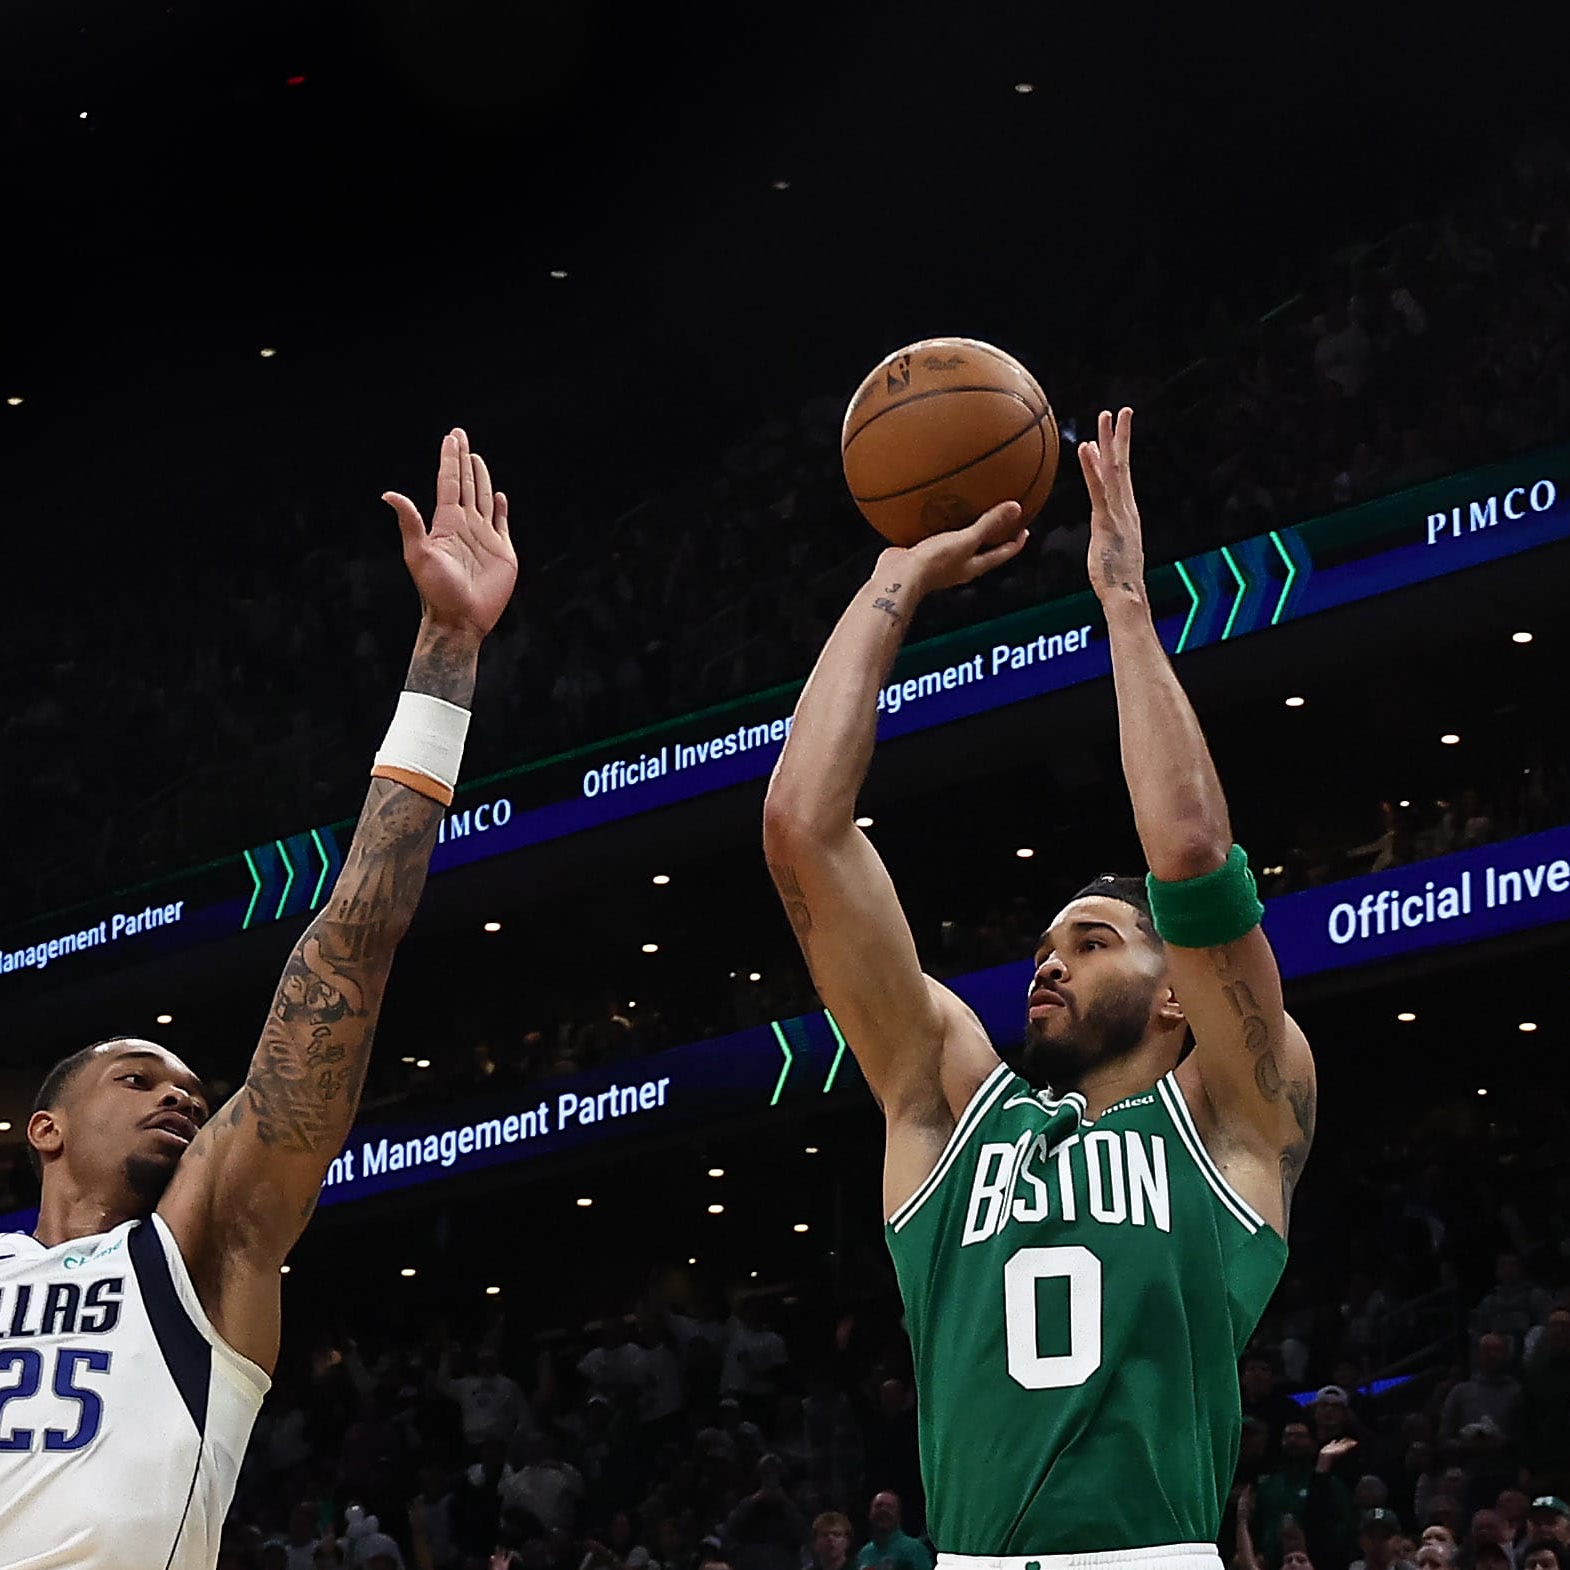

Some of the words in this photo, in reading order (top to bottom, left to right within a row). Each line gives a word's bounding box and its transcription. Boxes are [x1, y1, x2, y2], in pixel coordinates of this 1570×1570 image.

[1427, 480, 1556, 545] PIMCO
[583, 746, 667, 798] Official
[675, 717, 792, 772] Investme
[992, 625, 1092, 676] Partner
[438, 796, 511, 844] IMCO
[111, 900, 184, 940] Partner
[1328, 871, 1471, 944] Official
[362, 1101, 549, 1178] Management
[558, 1077, 670, 1131] Partner
[961, 1130, 1172, 1248] BOSTON
[1004, 1245, 1103, 1390] 0
